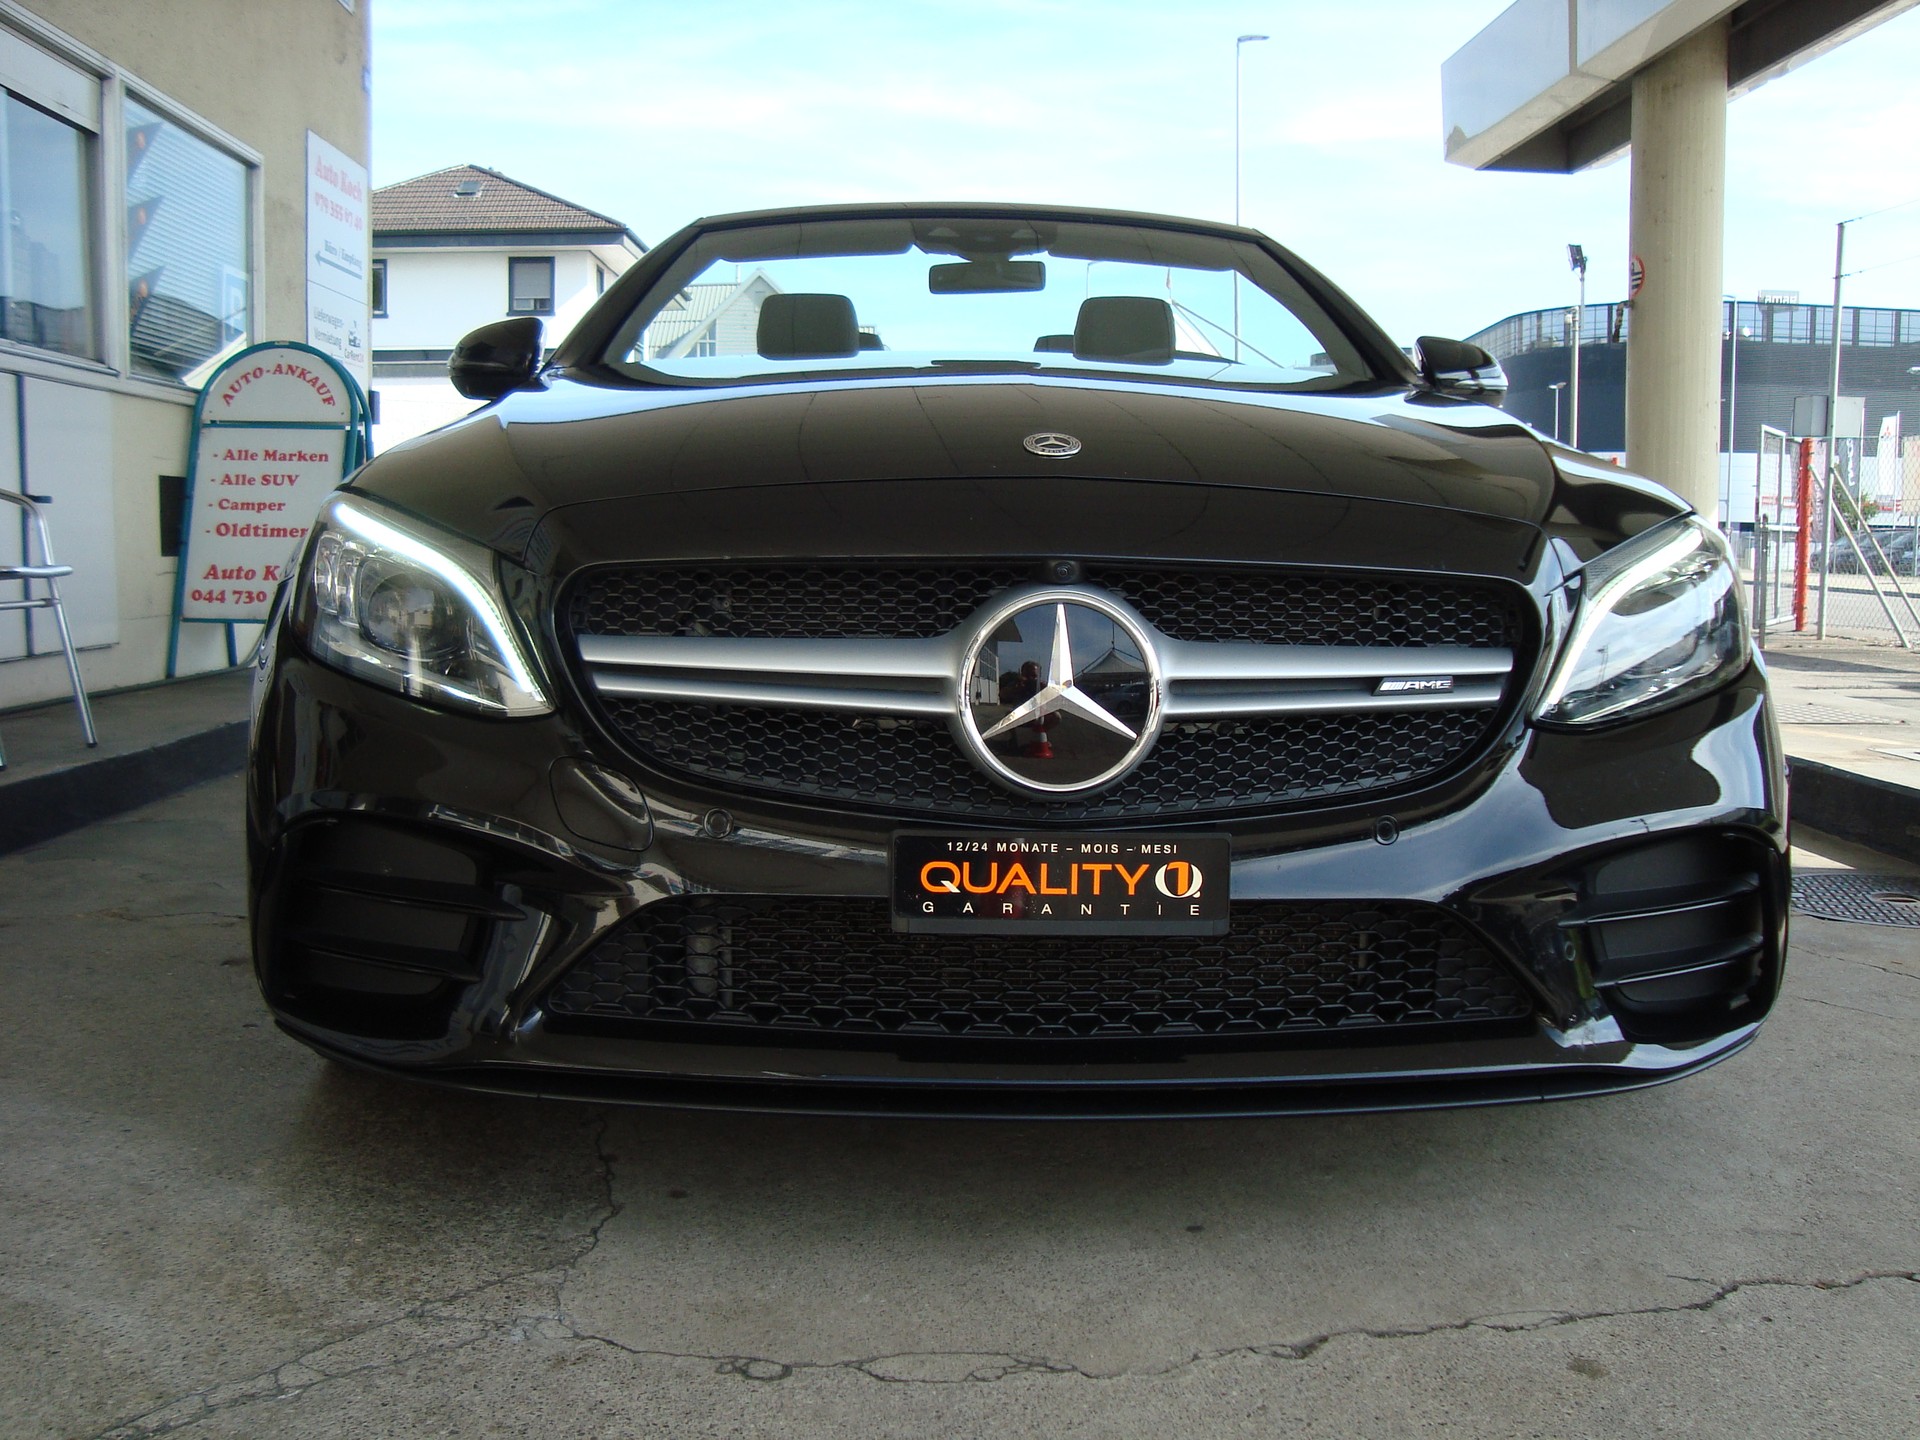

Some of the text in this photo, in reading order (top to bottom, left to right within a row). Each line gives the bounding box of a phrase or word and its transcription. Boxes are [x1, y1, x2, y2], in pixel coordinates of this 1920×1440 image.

[222, 363, 336, 407] AUTO-ANKAUF
[223, 449, 258, 461] Alle
[263, 450, 329, 462] Marken
[221, 473, 256, 486] Alle
[261, 474, 300, 486] SUV
[218, 499, 286, 513] Camper
[215, 522, 309, 538] Oldtimer
[203, 564, 280, 581] Auto K
[191, 589, 267, 604] 044 730
[1402, 680, 1452, 690] AMG
[947, 842, 988, 852] 12/24
[996, 842, 1059, 853] MONATE
[1080, 843, 1119, 854] MOIS
[1141, 844, 1178, 854] MESI
[920, 861, 1150, 896] QUALITY
[922, 901, 1200, 916] GARANTIE
